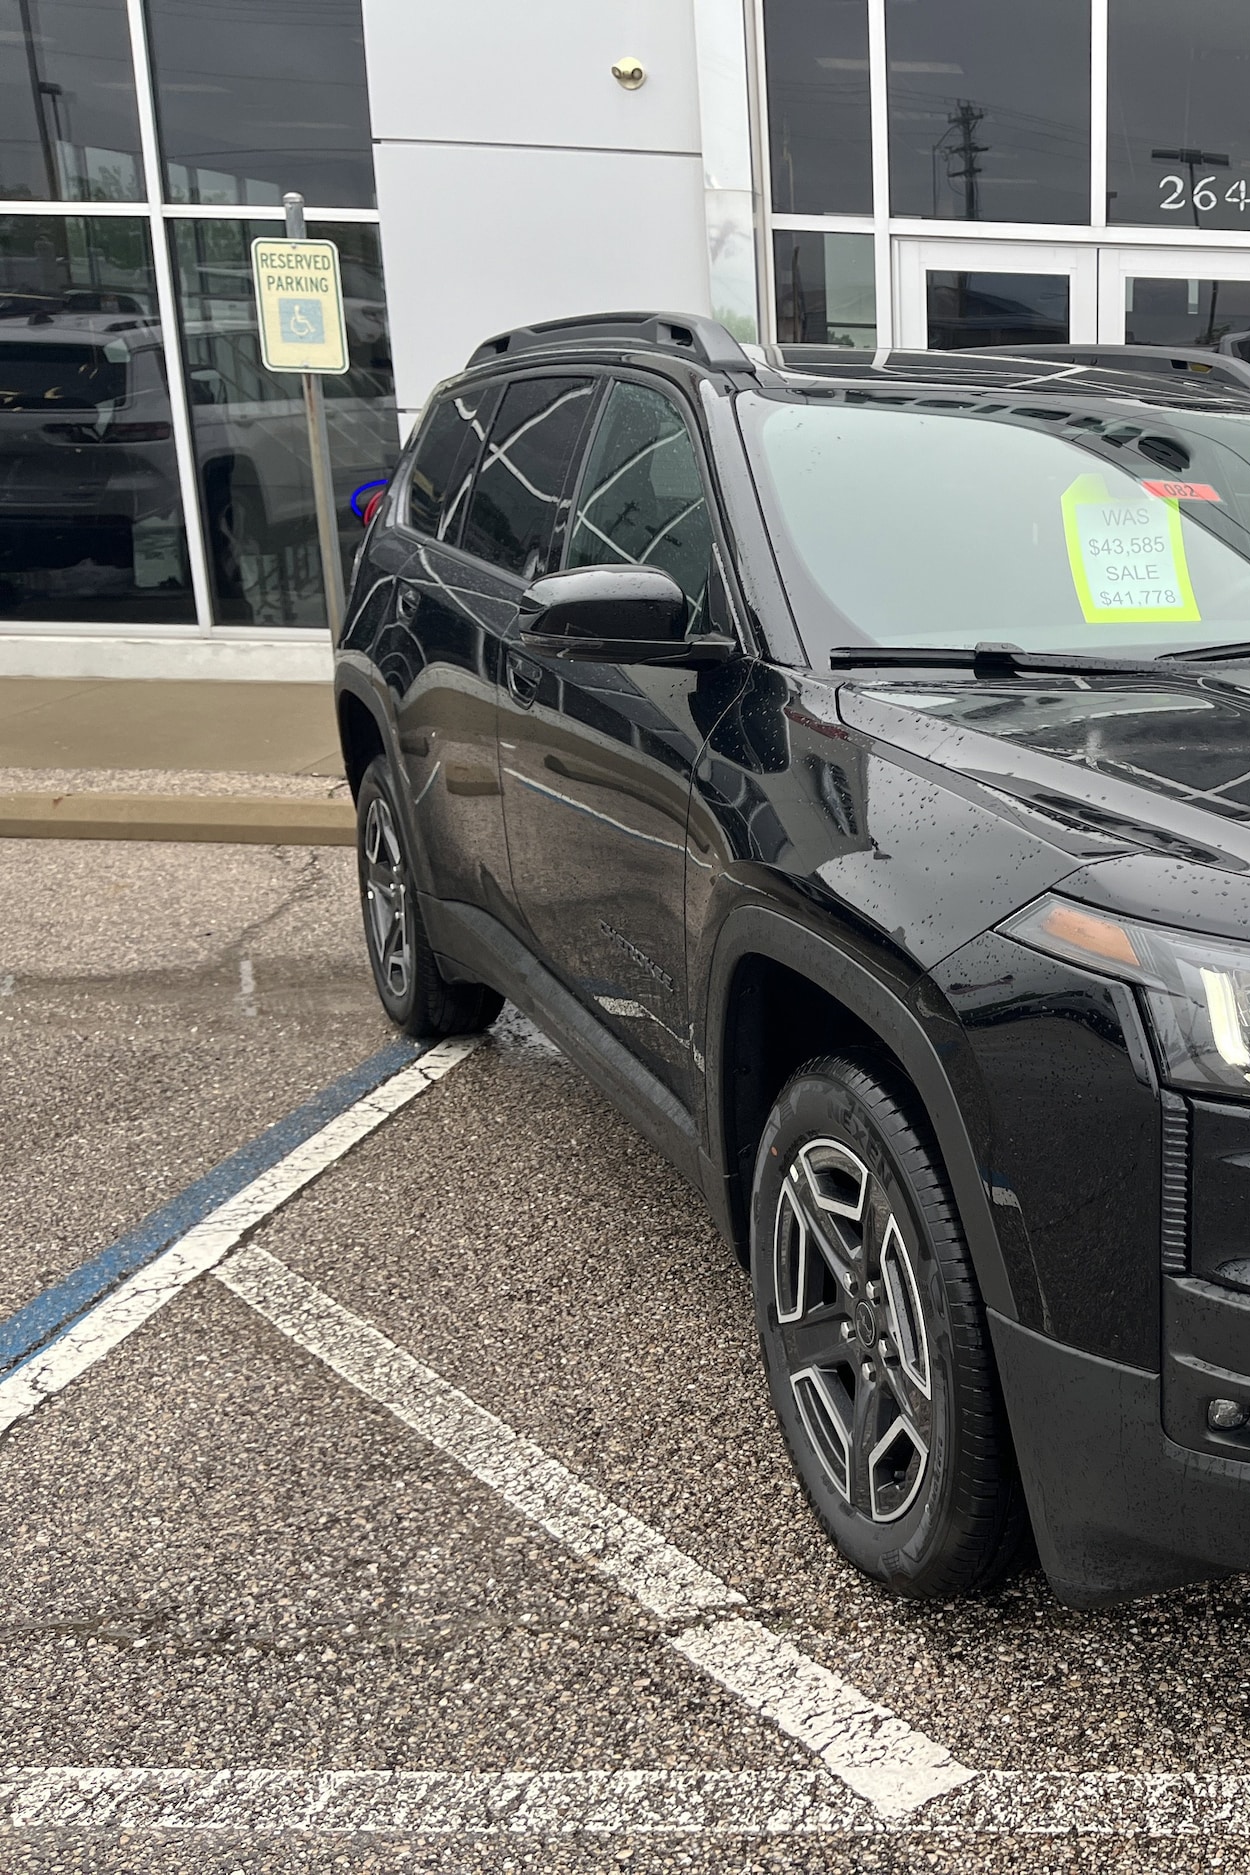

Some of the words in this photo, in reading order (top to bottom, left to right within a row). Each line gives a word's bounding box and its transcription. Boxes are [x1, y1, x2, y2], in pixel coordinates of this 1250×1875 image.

[260, 252, 331, 270] RESERVED
[267, 276, 329, 293] PARKING
[1163, 483, 1198, 497] 082
[1102, 508, 1150, 526] WAS
[1088, 536, 1165, 556] $43,585
[1106, 564, 1160, 581] SALE
[1099, 589, 1176, 606] $41,778
